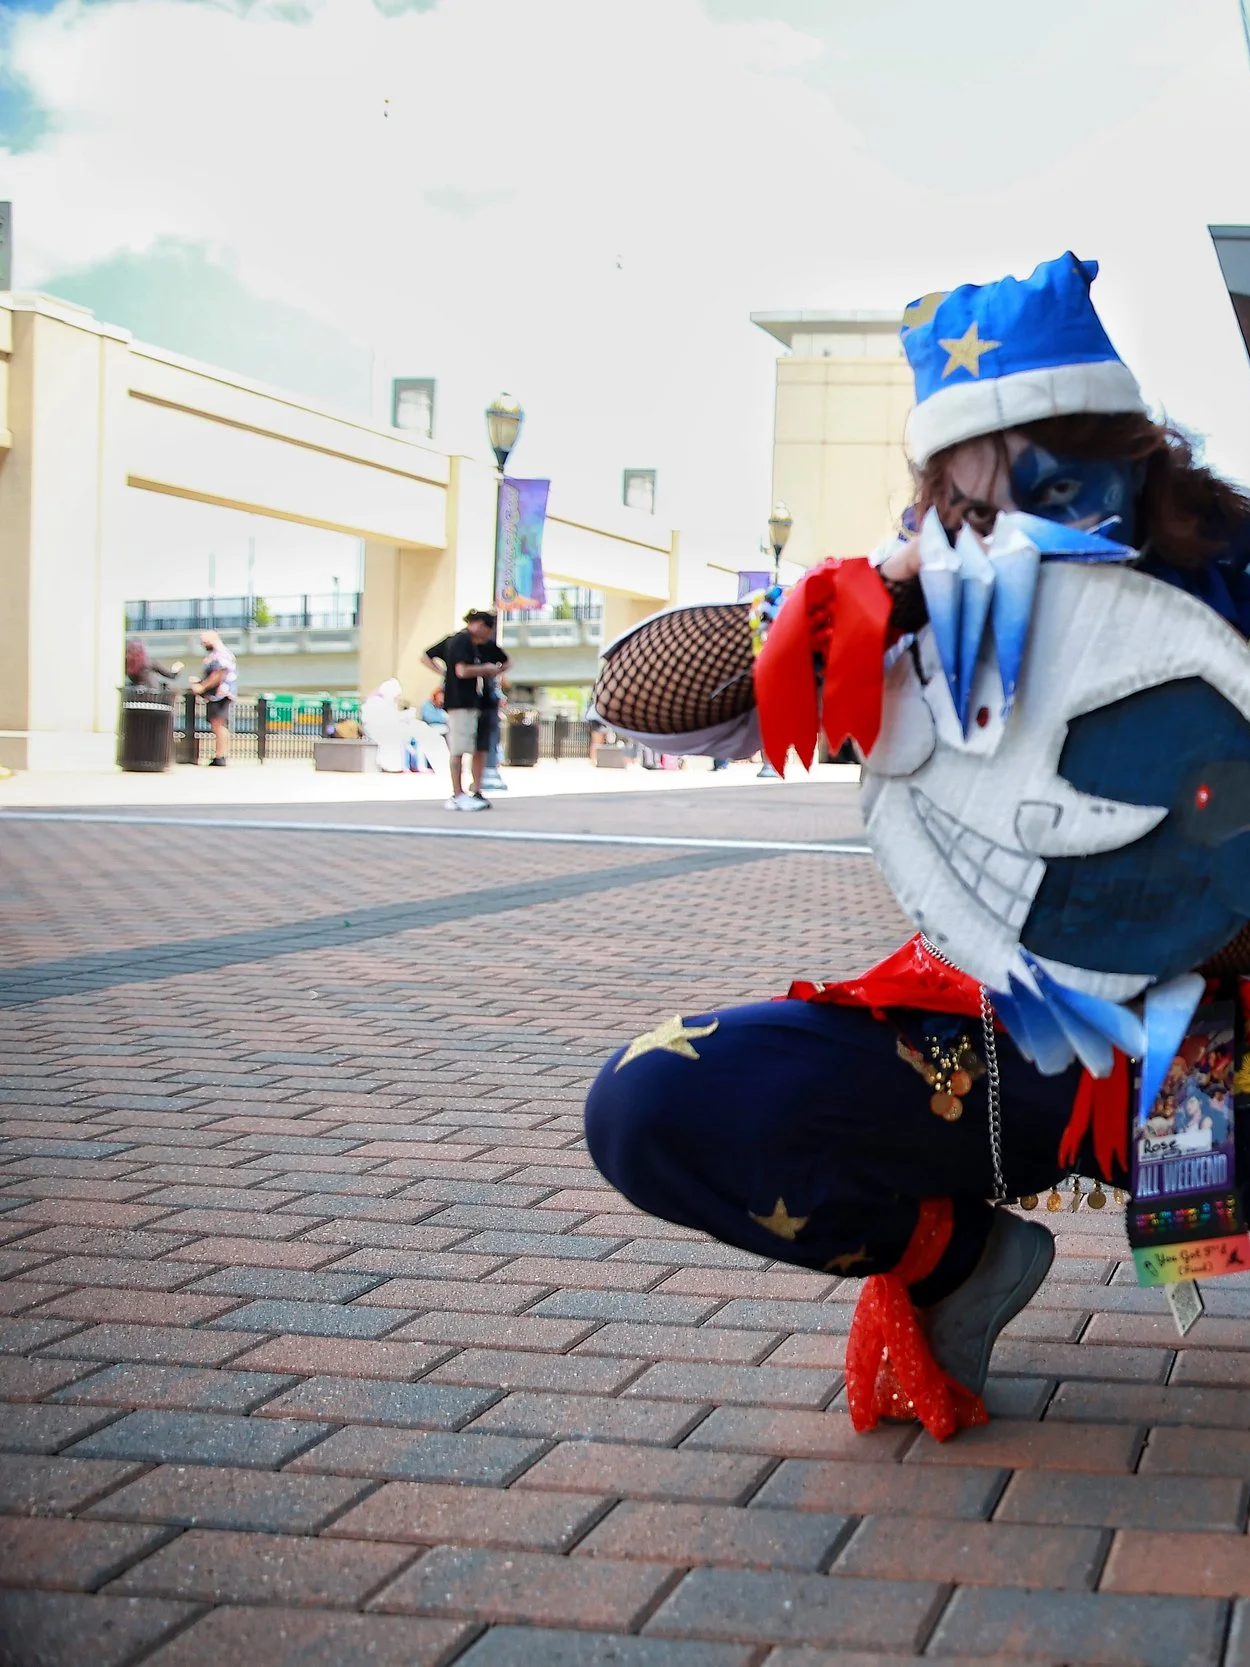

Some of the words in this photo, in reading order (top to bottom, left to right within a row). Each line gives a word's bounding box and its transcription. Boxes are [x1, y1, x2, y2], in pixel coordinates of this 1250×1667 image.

[1144, 1138, 1177, 1155] Rose
[1136, 1162, 1161, 1197] ALL
[1162, 1153, 1228, 1193] WEEKEND
